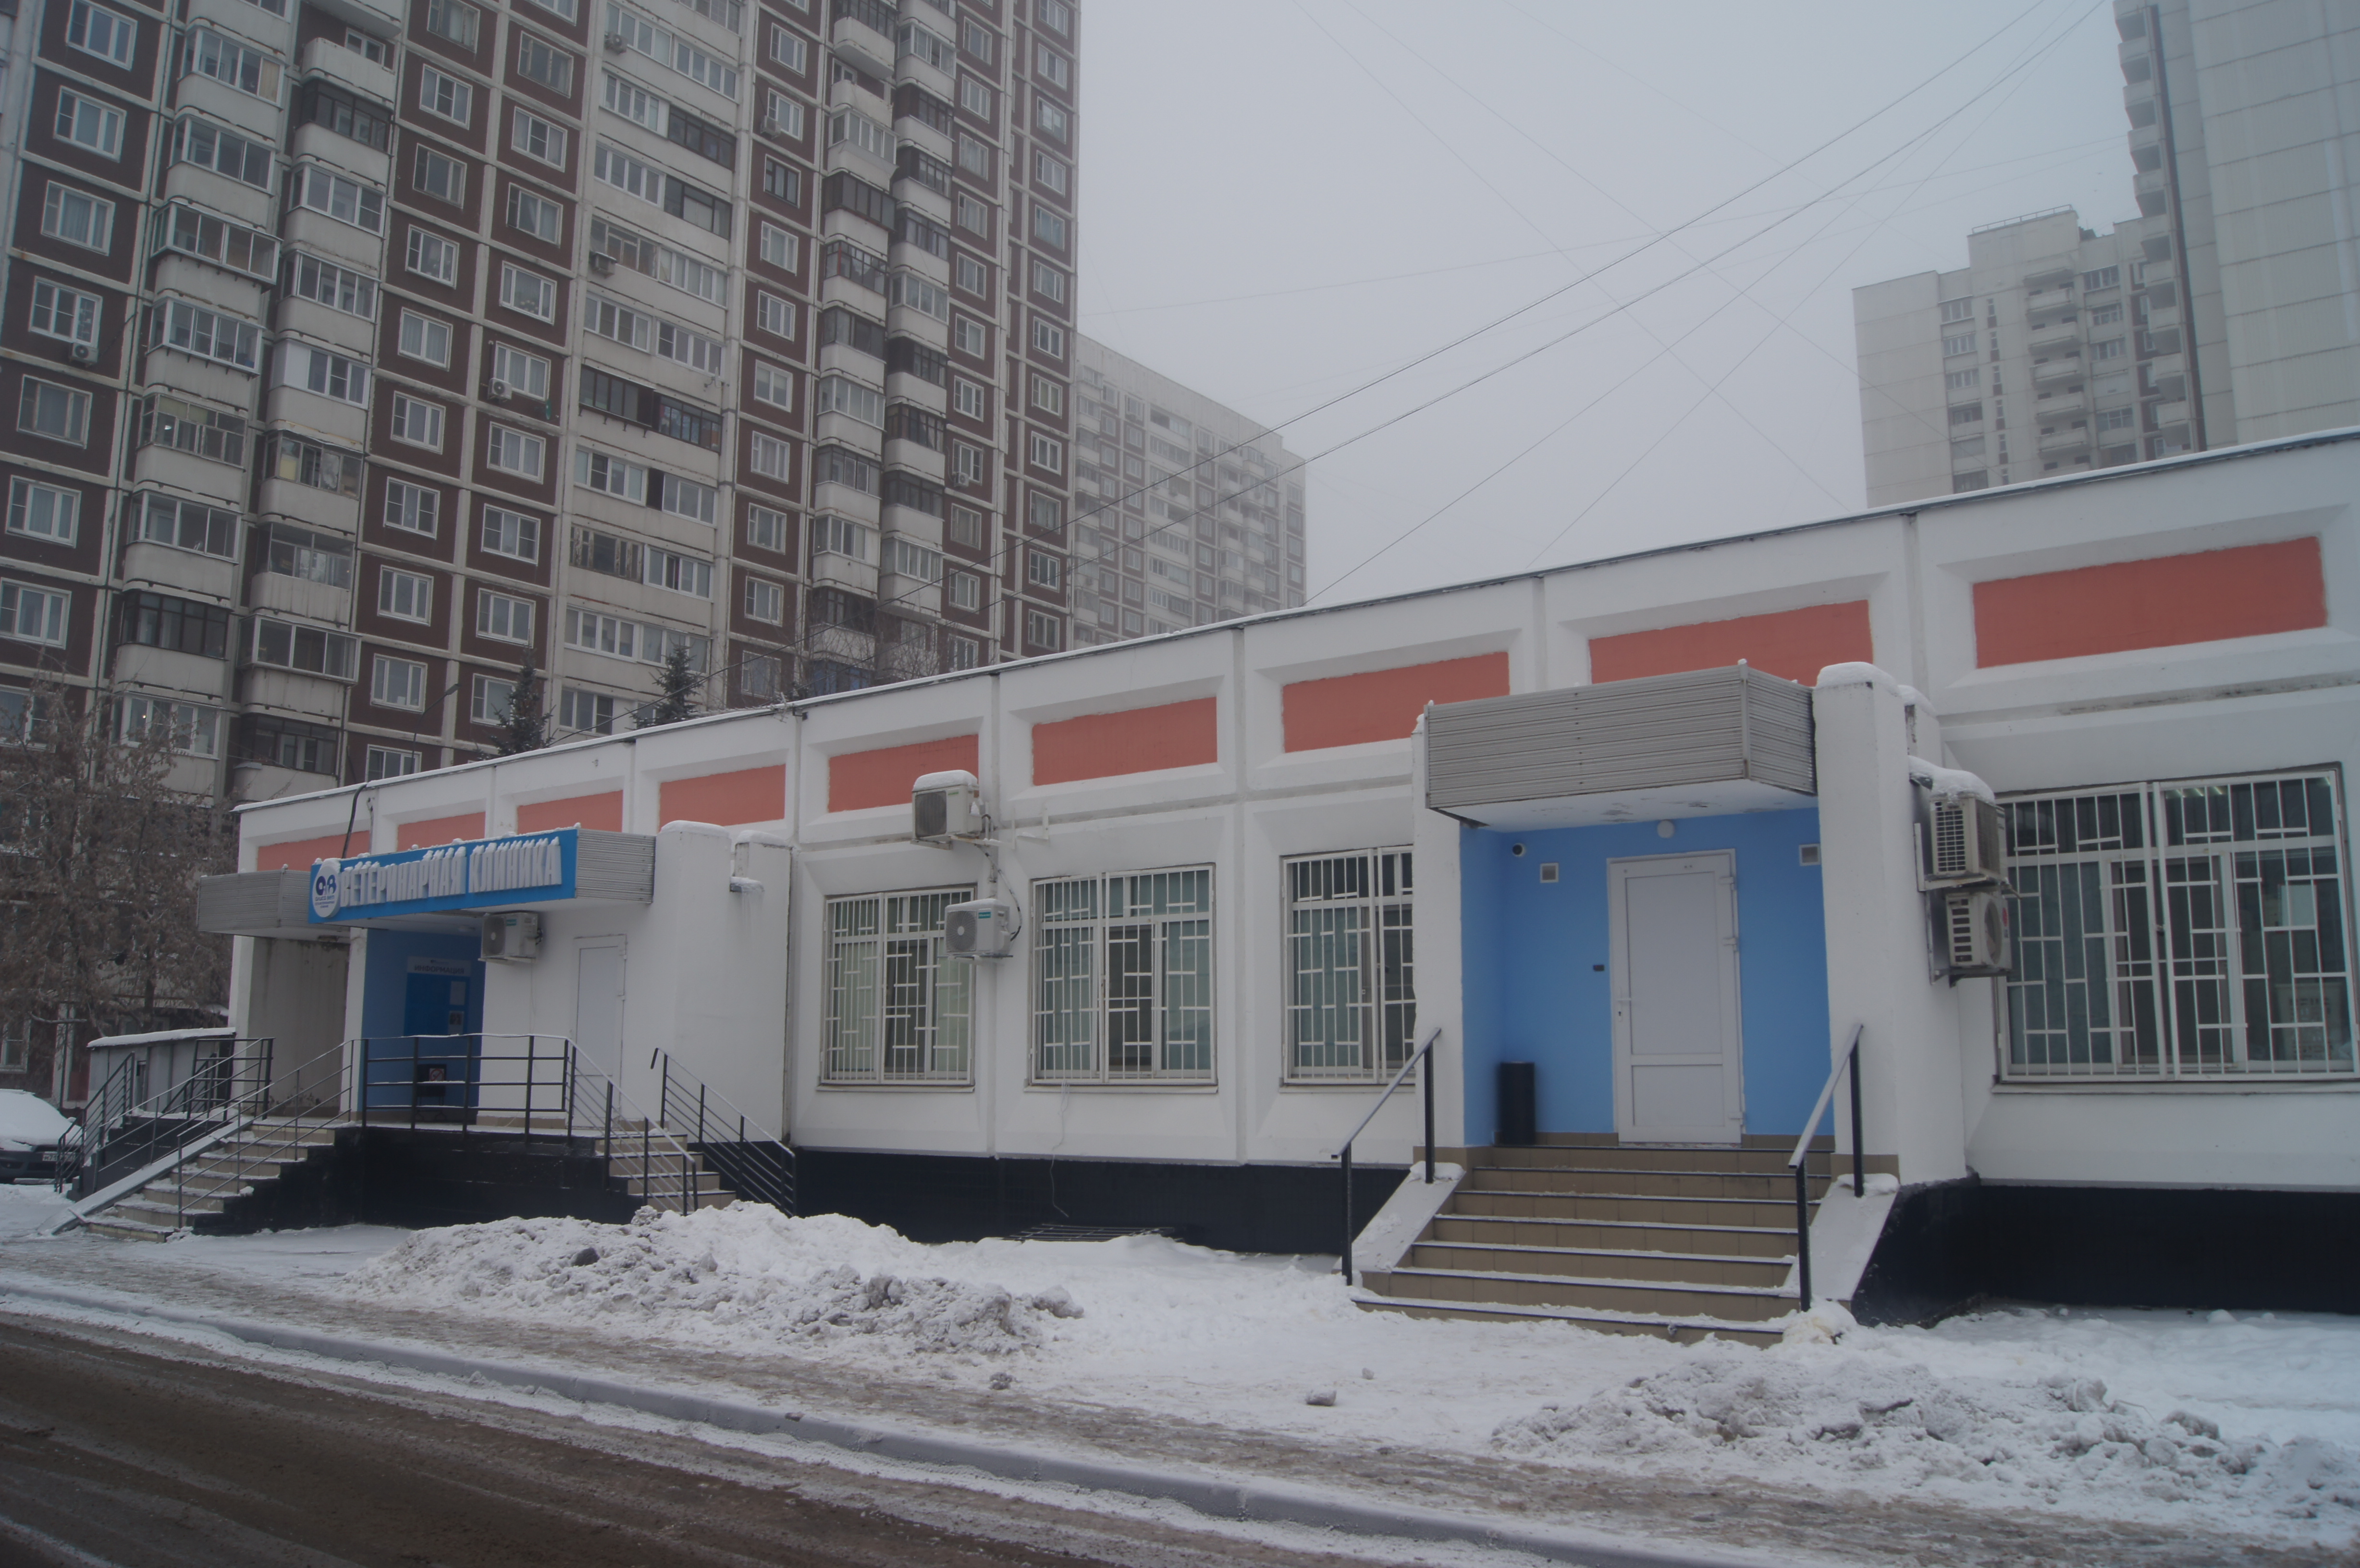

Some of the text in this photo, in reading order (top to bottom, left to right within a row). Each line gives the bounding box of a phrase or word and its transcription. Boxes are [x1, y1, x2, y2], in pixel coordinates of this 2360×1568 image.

[340, 844, 561, 907] ВЕТЕРИНАРНАЯ КЛИНИКА
[414, 965, 465, 974] ИНФОРМАЦИЯ
